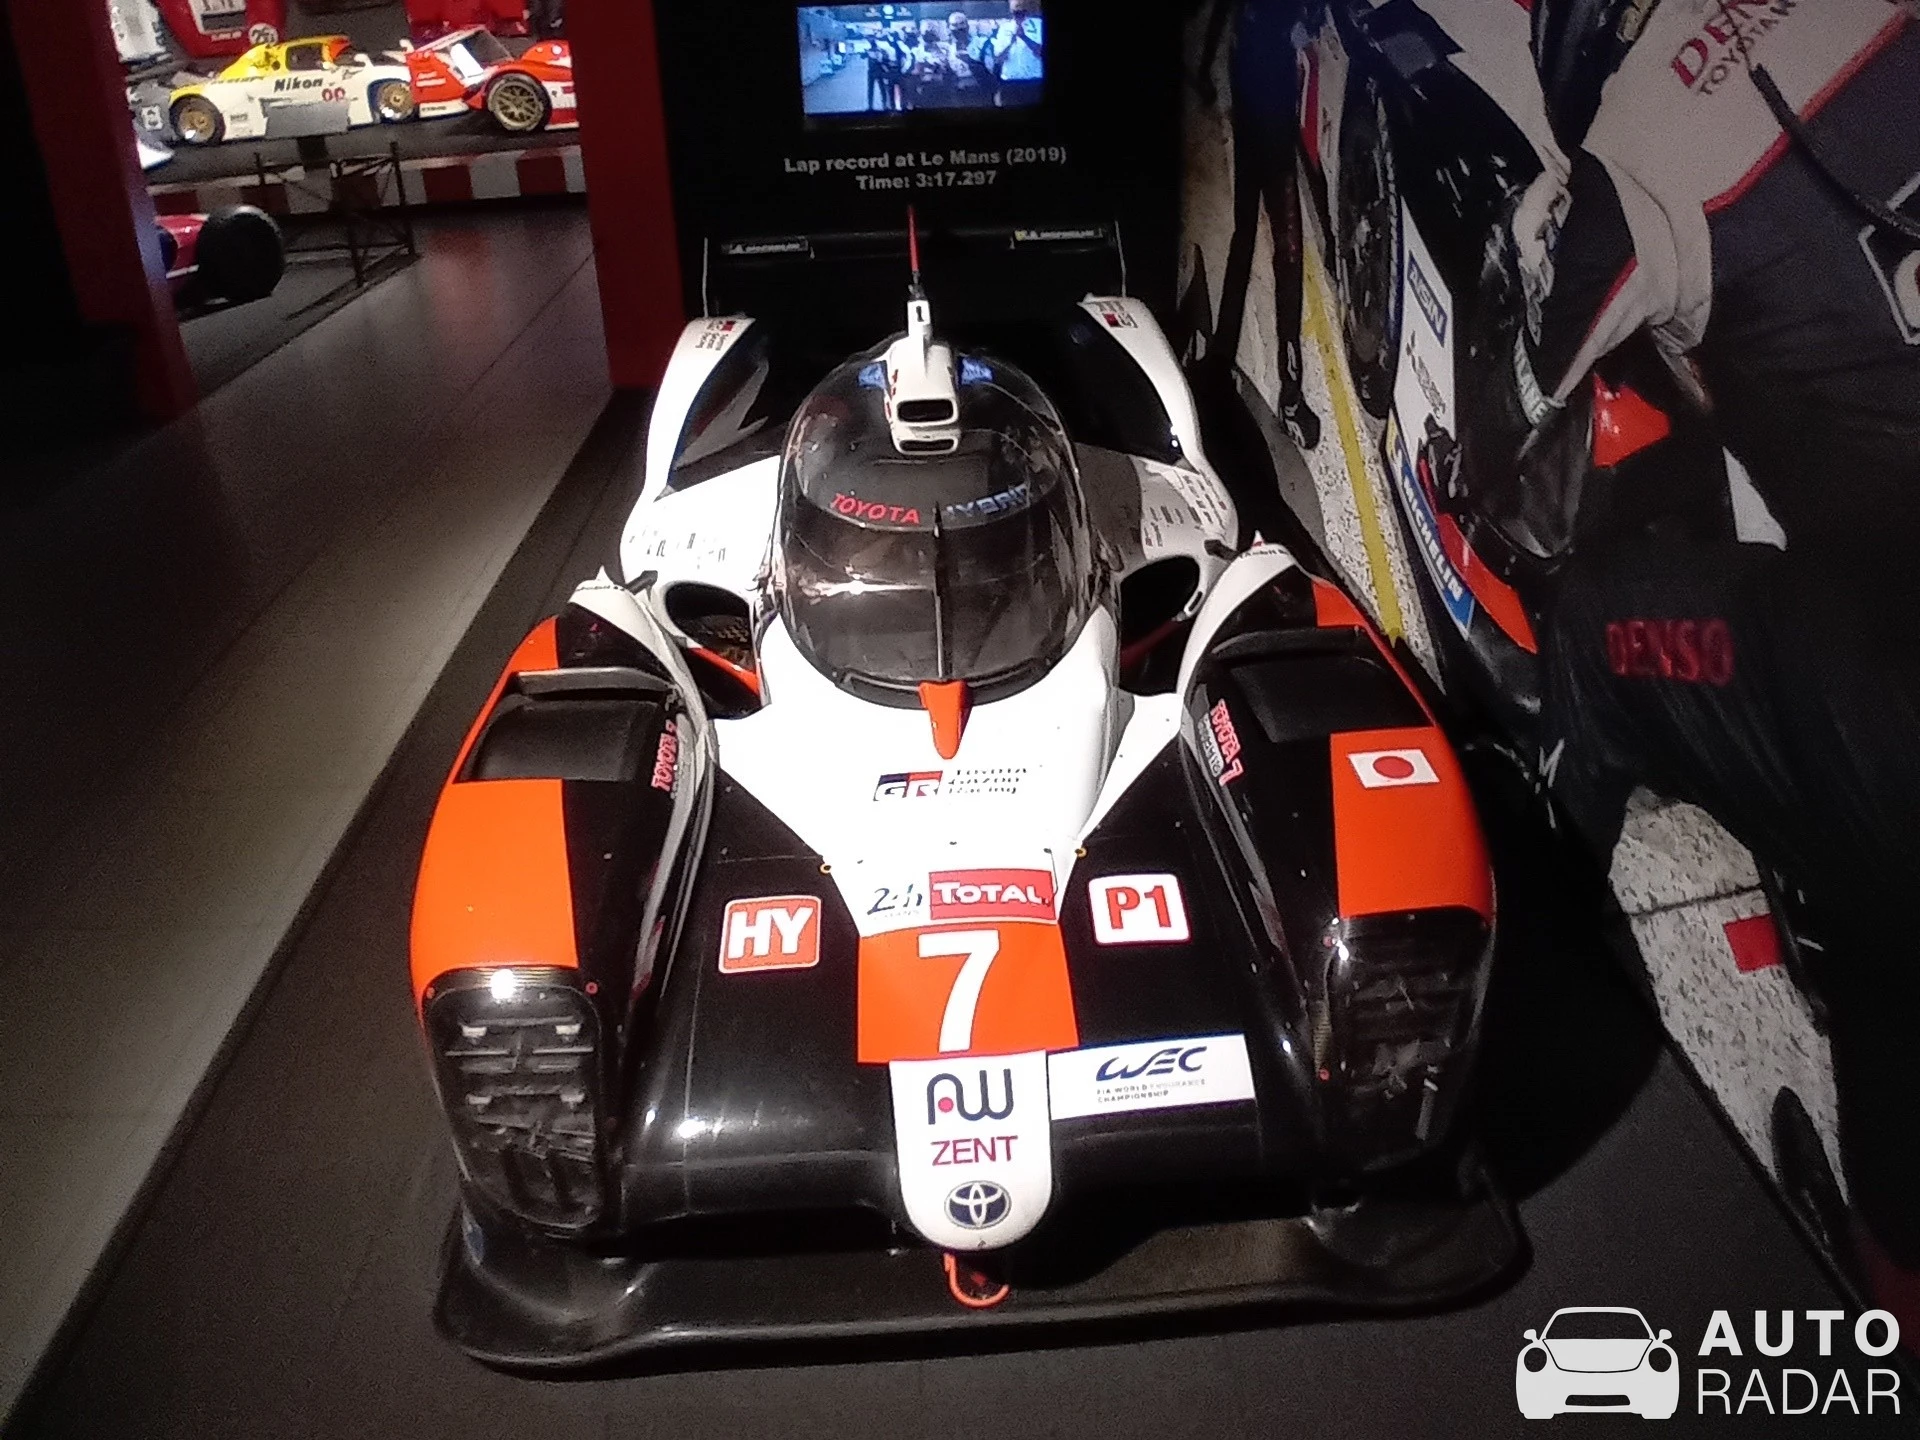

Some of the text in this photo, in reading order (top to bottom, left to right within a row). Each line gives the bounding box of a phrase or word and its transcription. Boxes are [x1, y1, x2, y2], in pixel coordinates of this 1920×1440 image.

[274, 76, 324, 93] Nikon
[784, 146, 1068, 176] Lap record at Le Mans (2019)
[855, 169, 998, 191] Time: 3:17.297
[830, 492, 921, 525] TOYOTA
[1402, 474, 1464, 602] MICHELIN
[1605, 618, 1736, 687] DENSO
[1209, 698, 1241, 764] TOYOTA
[872, 769, 944, 802] GR
[1105, 884, 1172, 931] P1
[727, 906, 815, 960] HY
[916, 928, 1001, 1054] 7
[1096, 1046, 1208, 1082] WEC
[1097, 1089, 1169, 1104] CHAMPIONSHIP
[930, 1134, 1019, 1166] ZENT
